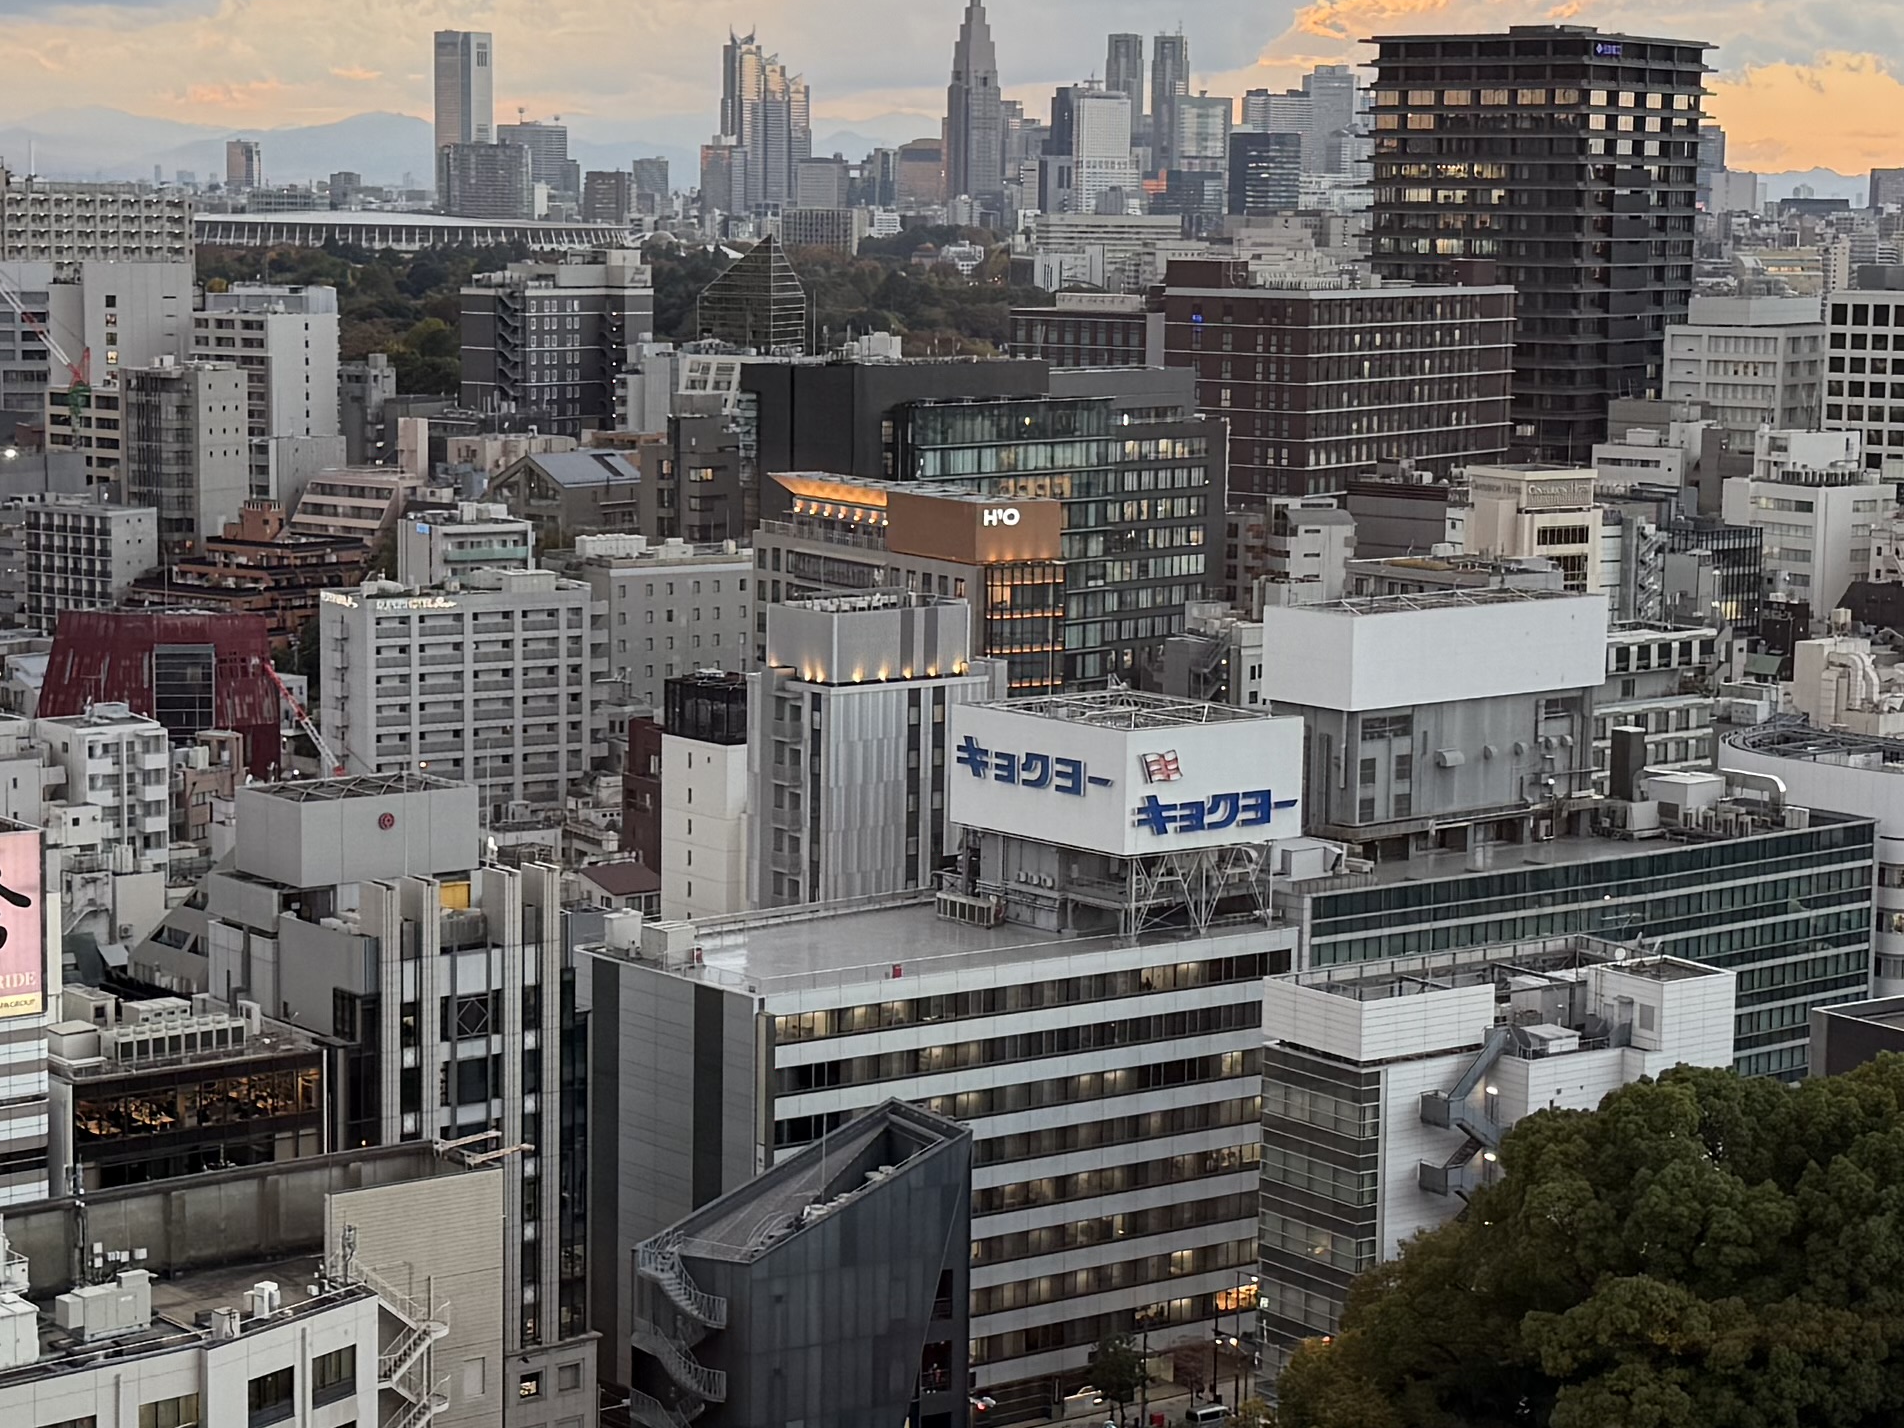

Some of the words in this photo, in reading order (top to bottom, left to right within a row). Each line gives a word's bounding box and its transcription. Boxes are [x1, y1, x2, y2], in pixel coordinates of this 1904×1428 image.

[956, 735, 1115, 797] キョクヨー
[1134, 789, 1299, 836] キョクヨー
